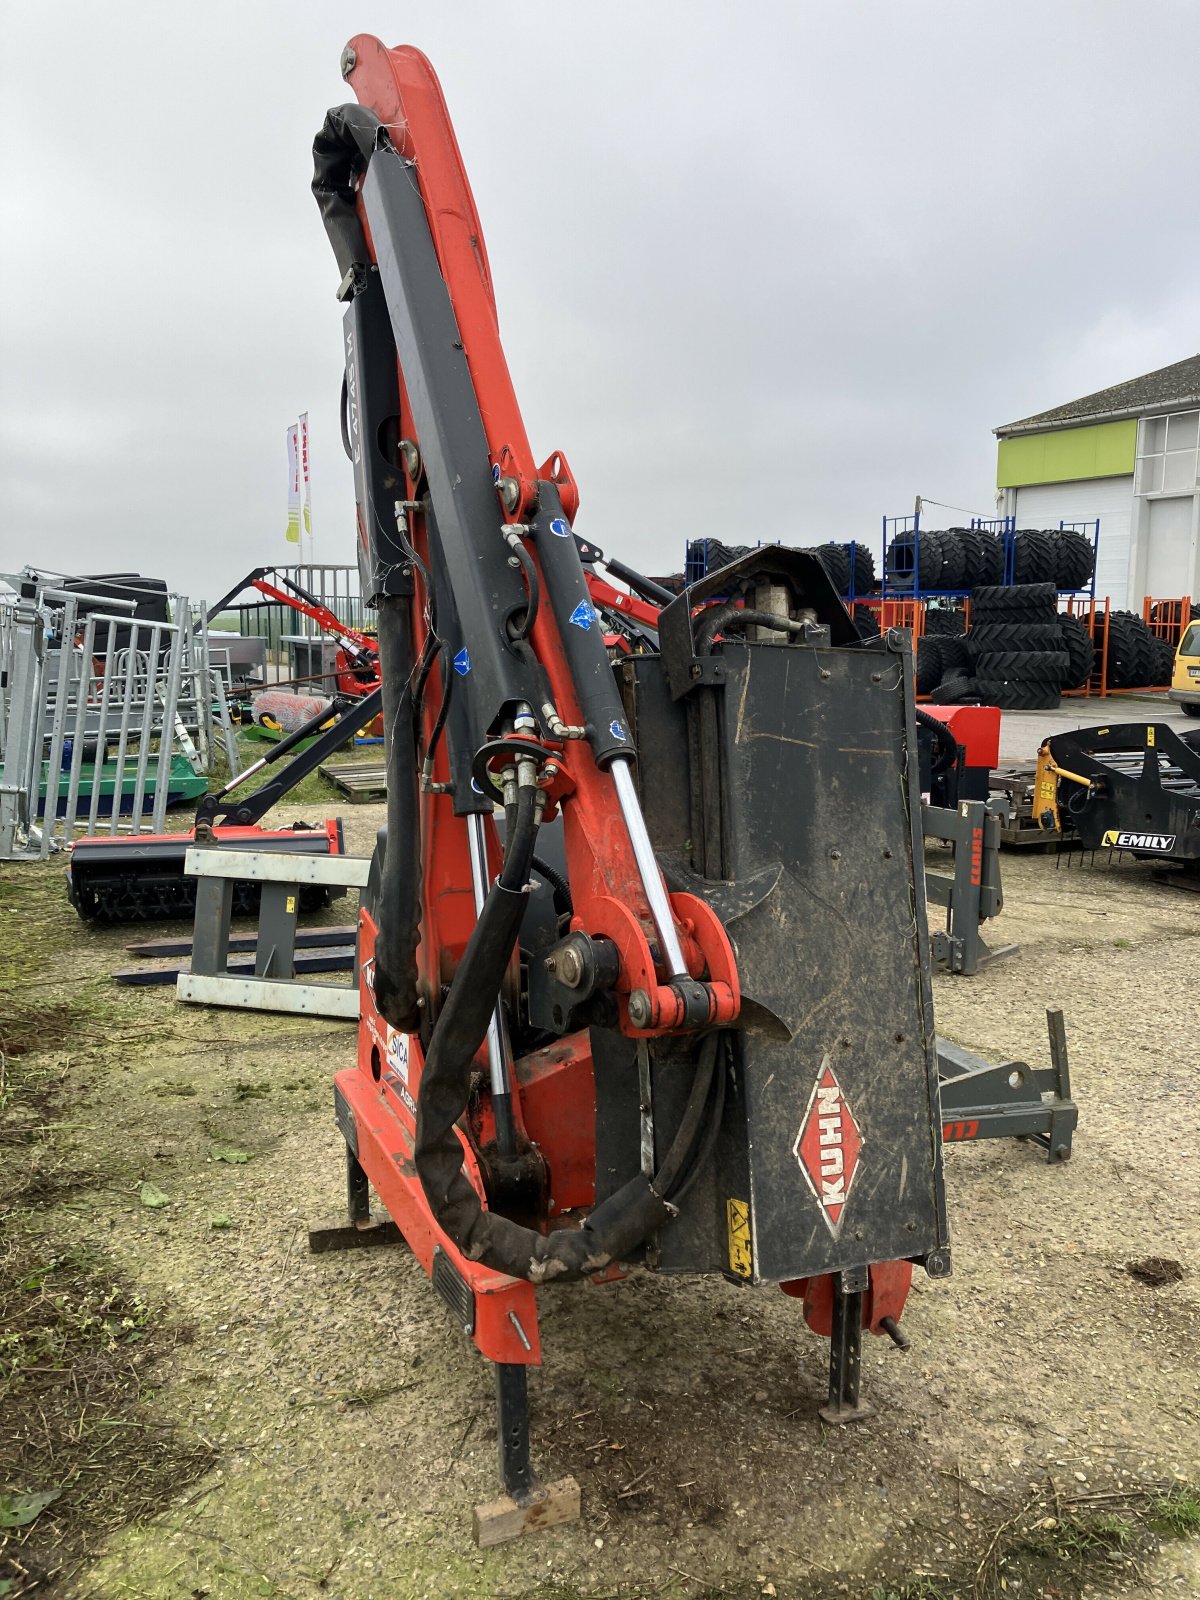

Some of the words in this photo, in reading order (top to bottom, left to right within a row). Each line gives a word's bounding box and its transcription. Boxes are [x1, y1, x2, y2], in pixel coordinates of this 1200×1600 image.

[345, 332, 354, 357] M
[348, 363, 359, 435] 4745
[354, 443, 361, 464] E
[970, 827, 982, 886] CLAAS
[1118, 834, 1172, 849] EMILY
[391, 1034, 408, 1068] SICA
[817, 1087, 845, 1206] KUHN
